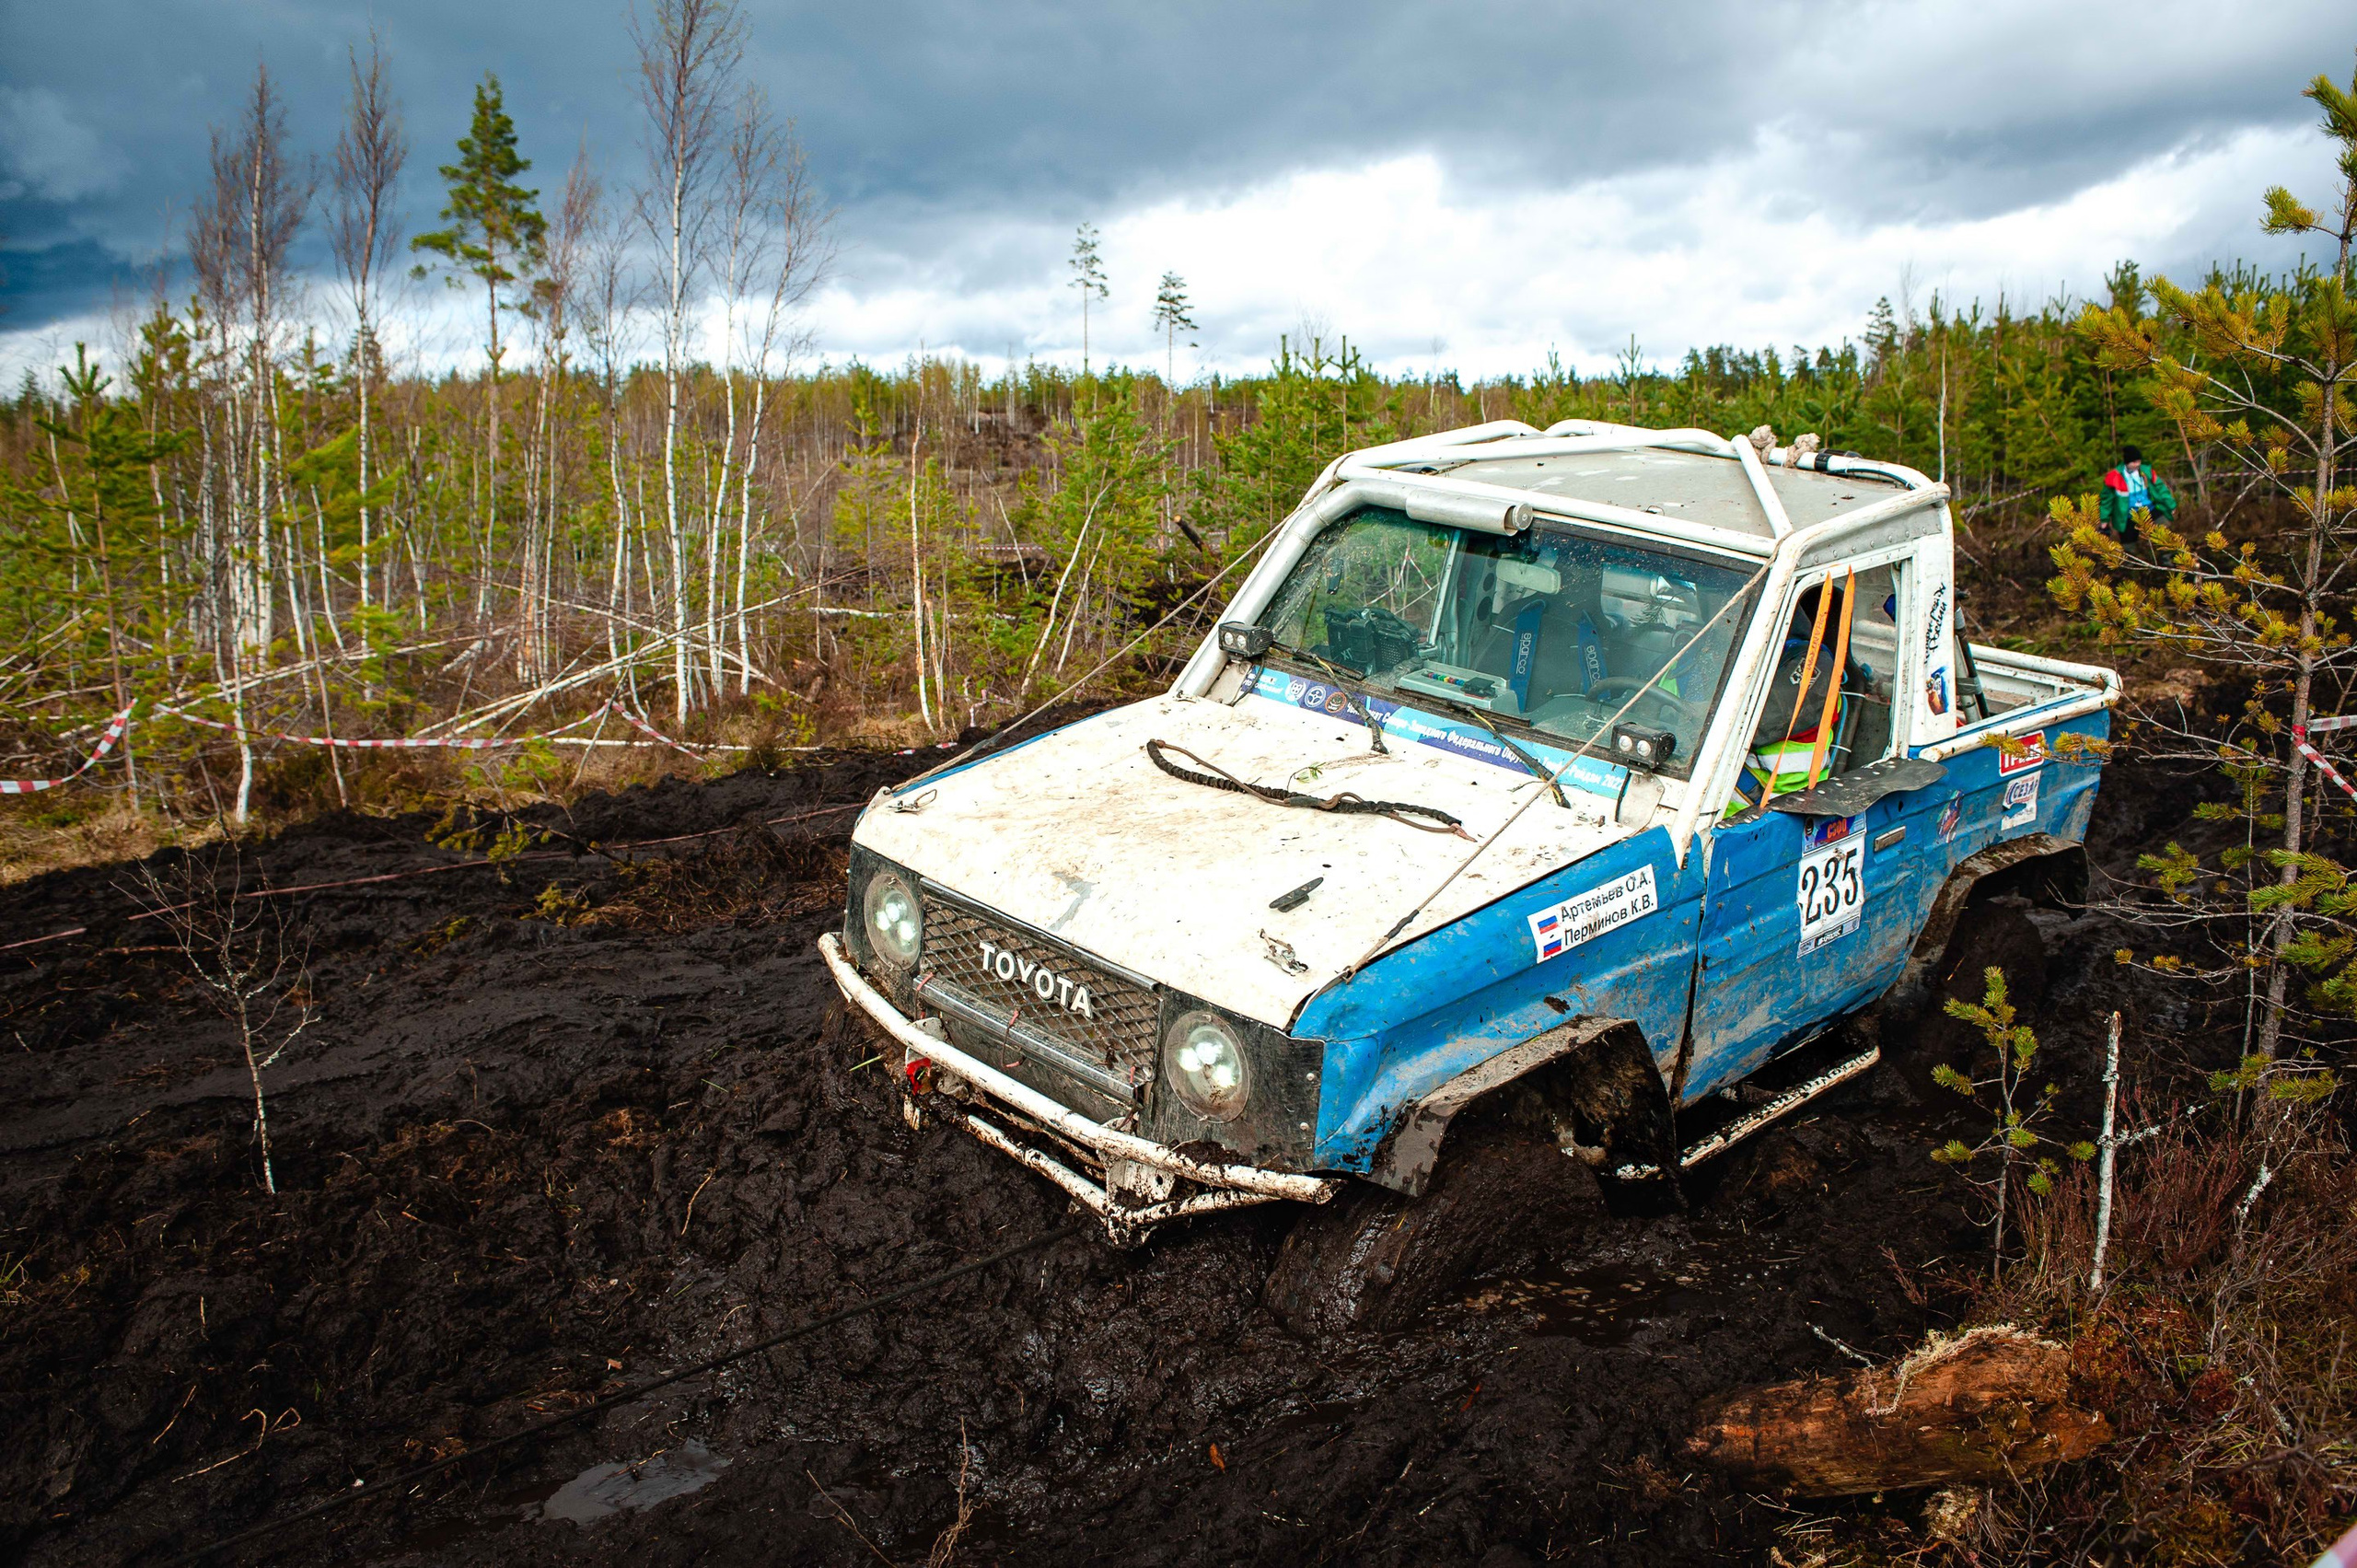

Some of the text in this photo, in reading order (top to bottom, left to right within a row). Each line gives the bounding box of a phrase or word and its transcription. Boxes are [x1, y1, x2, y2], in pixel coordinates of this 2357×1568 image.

[1446, 729, 1502, 757] Федерального
[1560, 875, 1653, 923] Артемьев О.А.
[1802, 848, 1857, 926] 235
[1564, 894, 1655, 947] Перминов К.В.
[980, 942, 1094, 1019] TOYOTA
